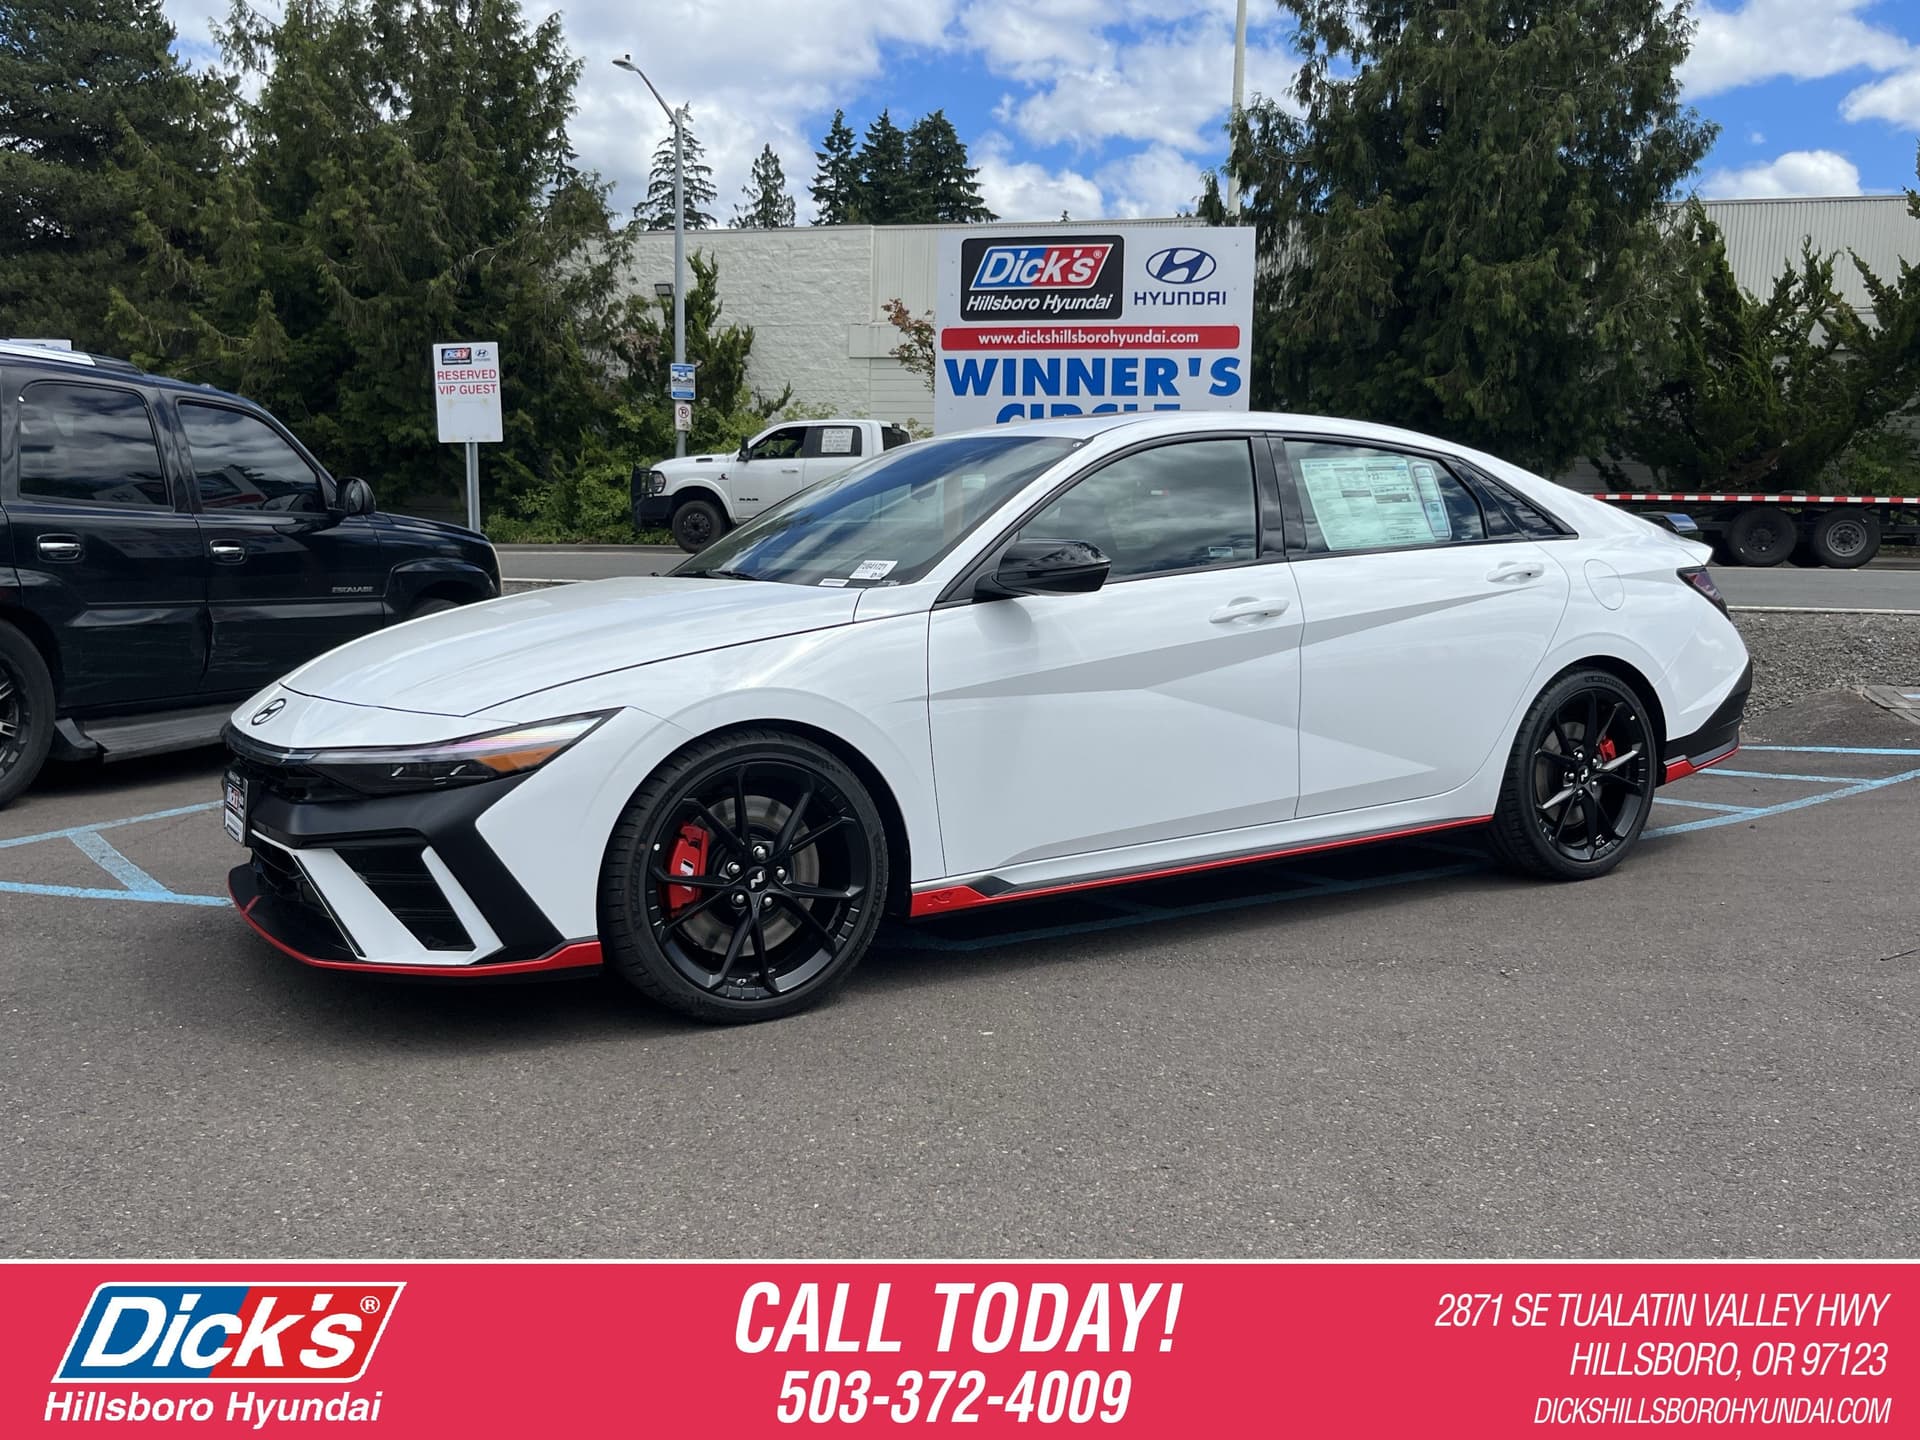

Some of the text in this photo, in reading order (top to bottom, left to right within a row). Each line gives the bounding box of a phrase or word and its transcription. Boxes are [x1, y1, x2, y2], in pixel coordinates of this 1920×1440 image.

[980, 249, 1095, 284] Dick's
[966, 294, 1114, 314] Hillsboro Hyundai
[1133, 291, 1226, 306] HYUNDAI
[978, 329, 1199, 347] www.dickshillsborohyundai.com
[437, 369, 497, 380] RESERVED
[944, 357, 1241, 396] WINNER'S
[438, 384, 497, 395] VIP GUEST
